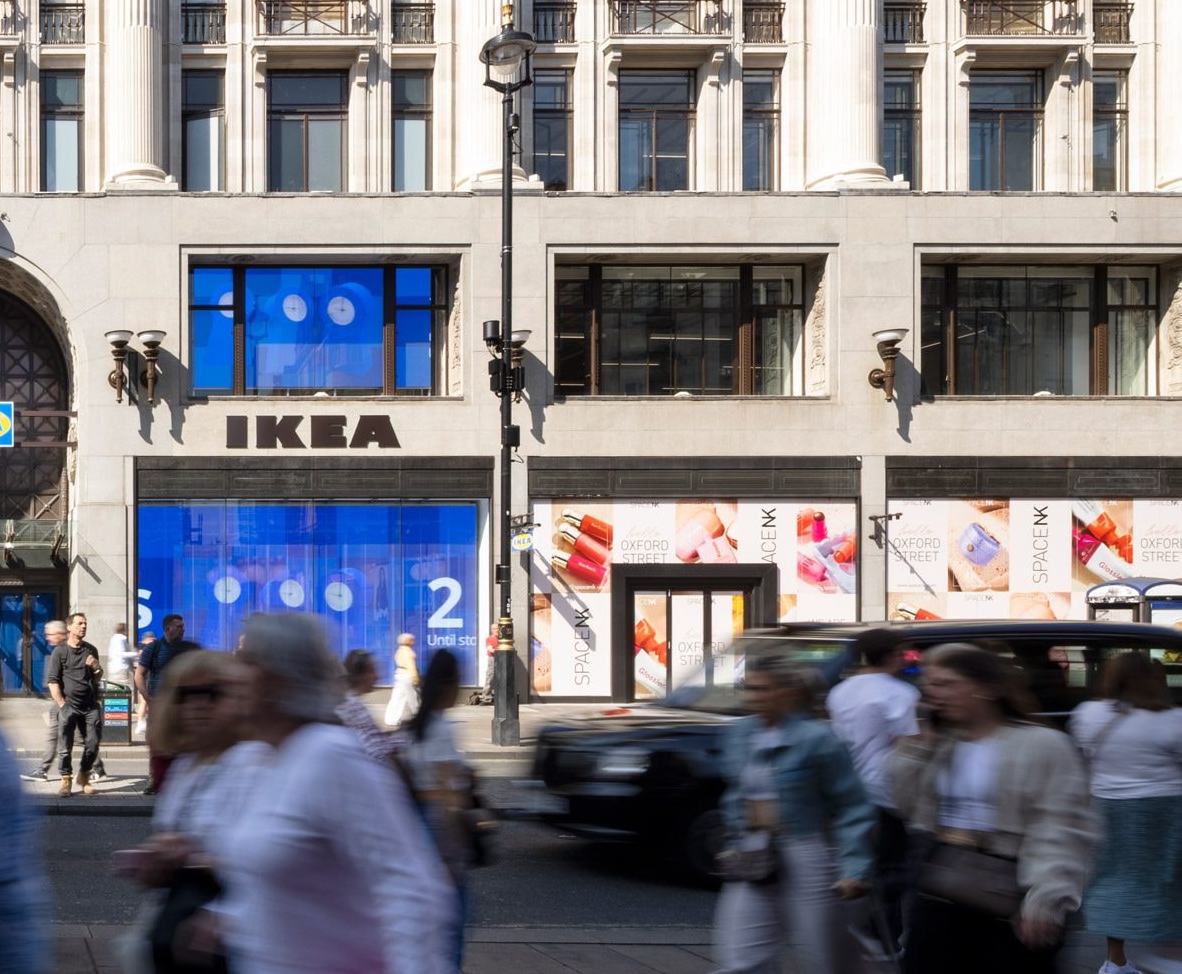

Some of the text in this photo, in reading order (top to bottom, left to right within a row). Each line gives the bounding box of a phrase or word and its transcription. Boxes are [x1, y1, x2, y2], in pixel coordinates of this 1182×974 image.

[226, 415, 401, 448] IKEA
[621, 540, 668, 551] OXFORD
[893, 538, 940, 549] OXFORD
[1033, 506, 1048, 583] SPACENK
[623, 553, 667, 564] STREET
[895, 551, 938, 562] STREET
[427, 577, 463, 628] 2
[427, 634, 456, 646] Until
[575, 608, 590, 685] SPACENK
